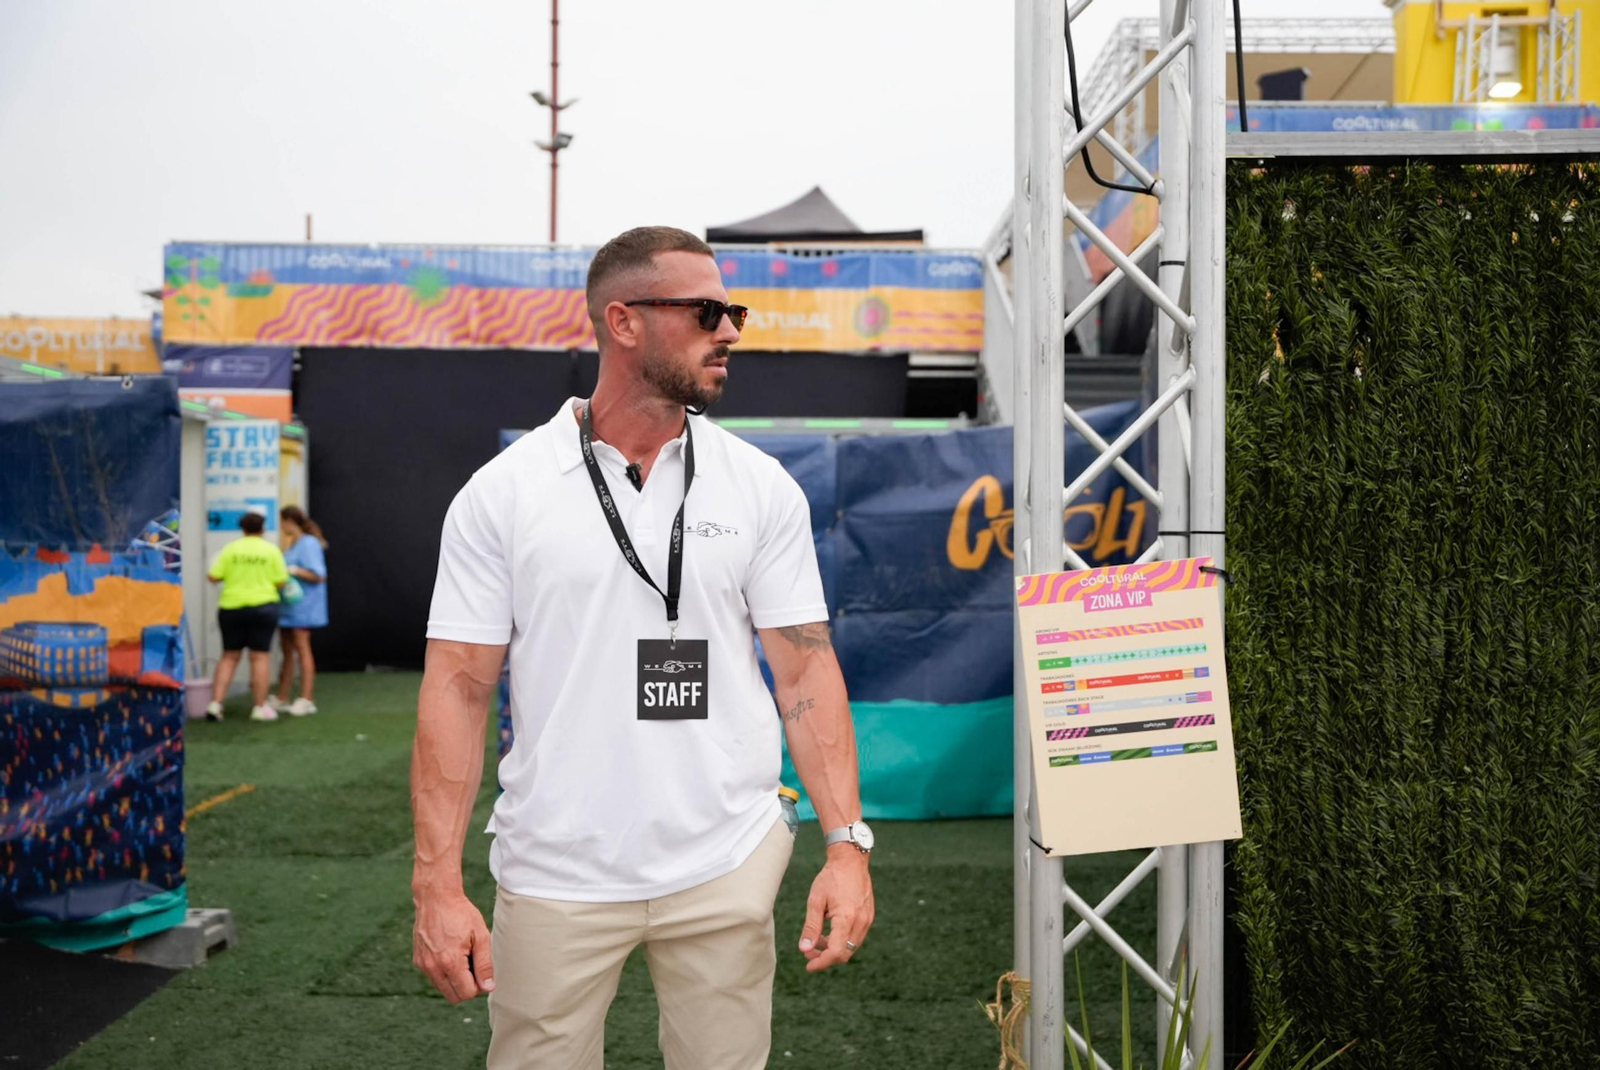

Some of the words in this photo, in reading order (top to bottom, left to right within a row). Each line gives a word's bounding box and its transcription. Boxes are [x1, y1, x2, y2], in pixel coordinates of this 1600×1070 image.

[0, 326, 147, 352] OOLTURAL
[207, 425, 278, 447] STAY
[207, 452, 277, 468] FRESH
[1080, 571, 1147, 587] COOLTURAL
[1090, 592, 1123, 610] ZONA
[1126, 590, 1146, 606] VIP
[643, 681, 702, 707] STAFF
